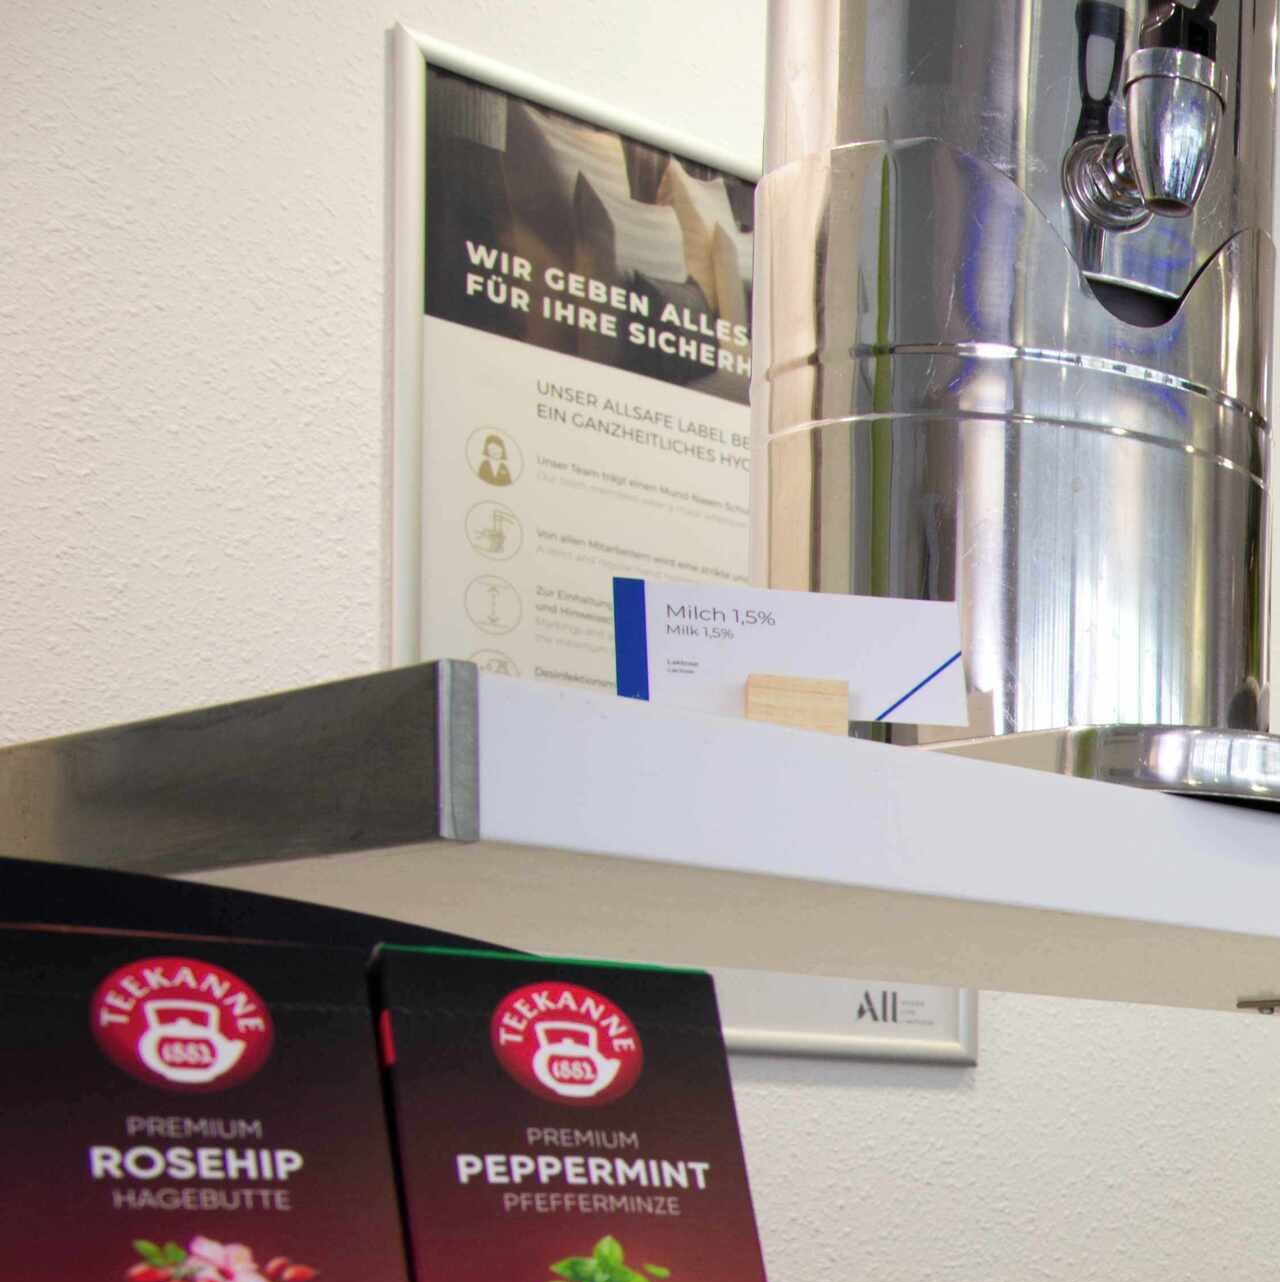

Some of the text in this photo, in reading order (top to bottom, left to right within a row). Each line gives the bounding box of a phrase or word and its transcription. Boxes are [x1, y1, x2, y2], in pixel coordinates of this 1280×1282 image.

[466, 240, 750, 348] WIR GEBEN ALLES
[465, 272, 750, 377] FÜR IHRE SICHERH
[536, 379, 599, 408] UNSER
[602, 398, 674, 430] ALLSAFE
[677, 418, 726, 445] LABEL
[536, 403, 567, 425] EIN
[572, 412, 716, 464] GANZHEITLICHES
[665, 603, 776, 627] Milch 1,5%
[666, 624, 735, 640] Milk 1,5%
[100, 966, 264, 1033] TEEKANNE
[499, 990, 636, 1053] TEEKANNE
[125, 1115, 263, 1140] PREMIUM
[526, 1127, 639, 1149] PREMIUM
[90, 1145, 304, 1181] ROSEHIP
[456, 1153, 710, 1190] PEPPERMINT
[112, 1186, 292, 1211] HAGEBUTTE
[503, 1192, 681, 1216] PFEFFERMINZE
